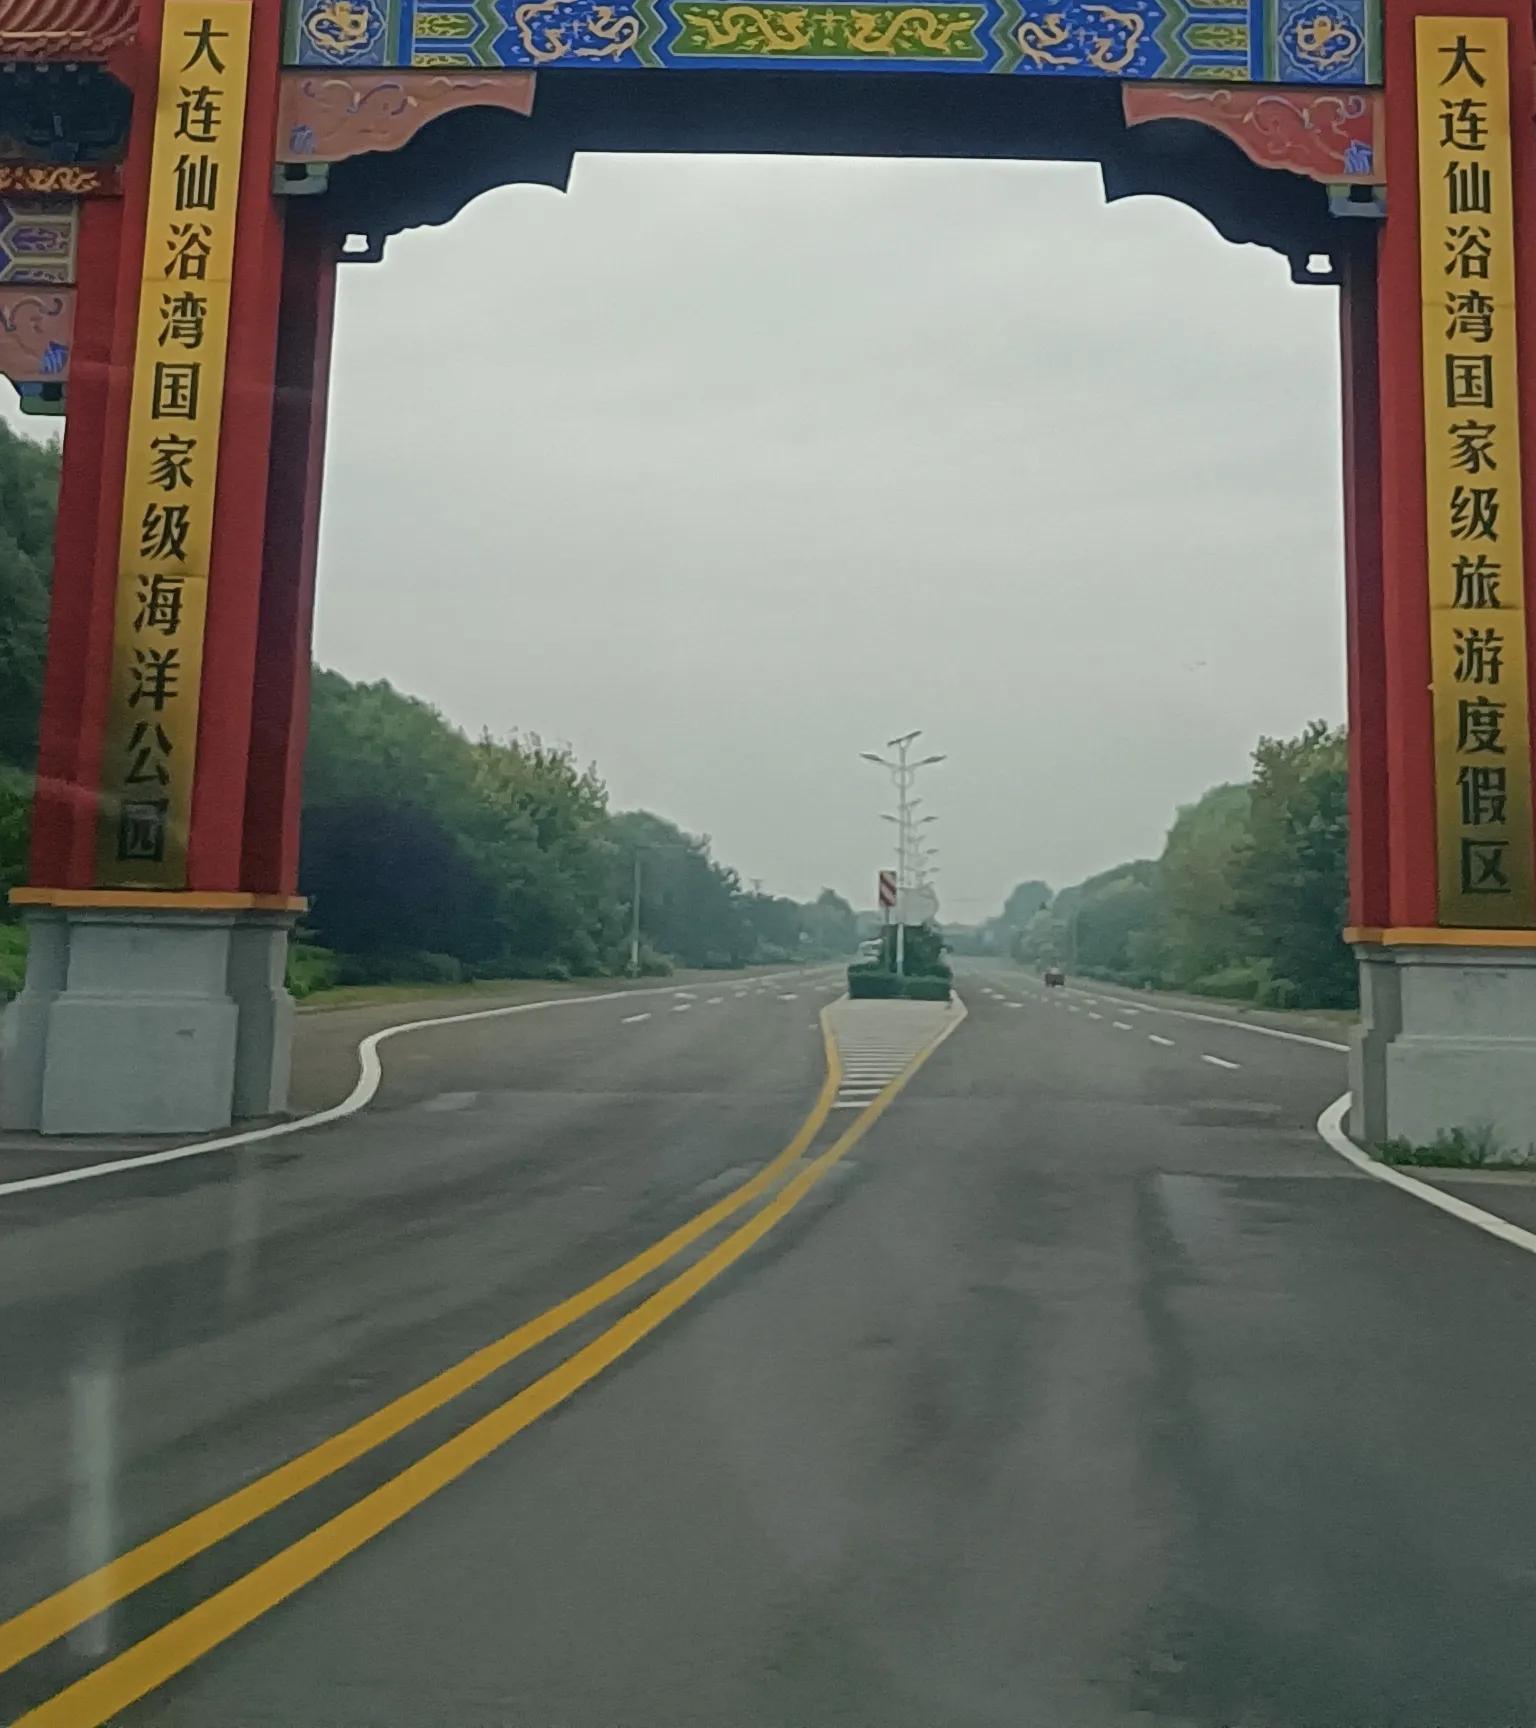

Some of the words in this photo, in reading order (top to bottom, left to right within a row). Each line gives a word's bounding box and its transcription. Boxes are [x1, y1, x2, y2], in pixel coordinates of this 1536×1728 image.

[117, 17, 230, 862] 大连仙浴湾国家级海洋公园
[1436, 34, 1512, 897] 大连仙浴湾国家级旅游度假区
